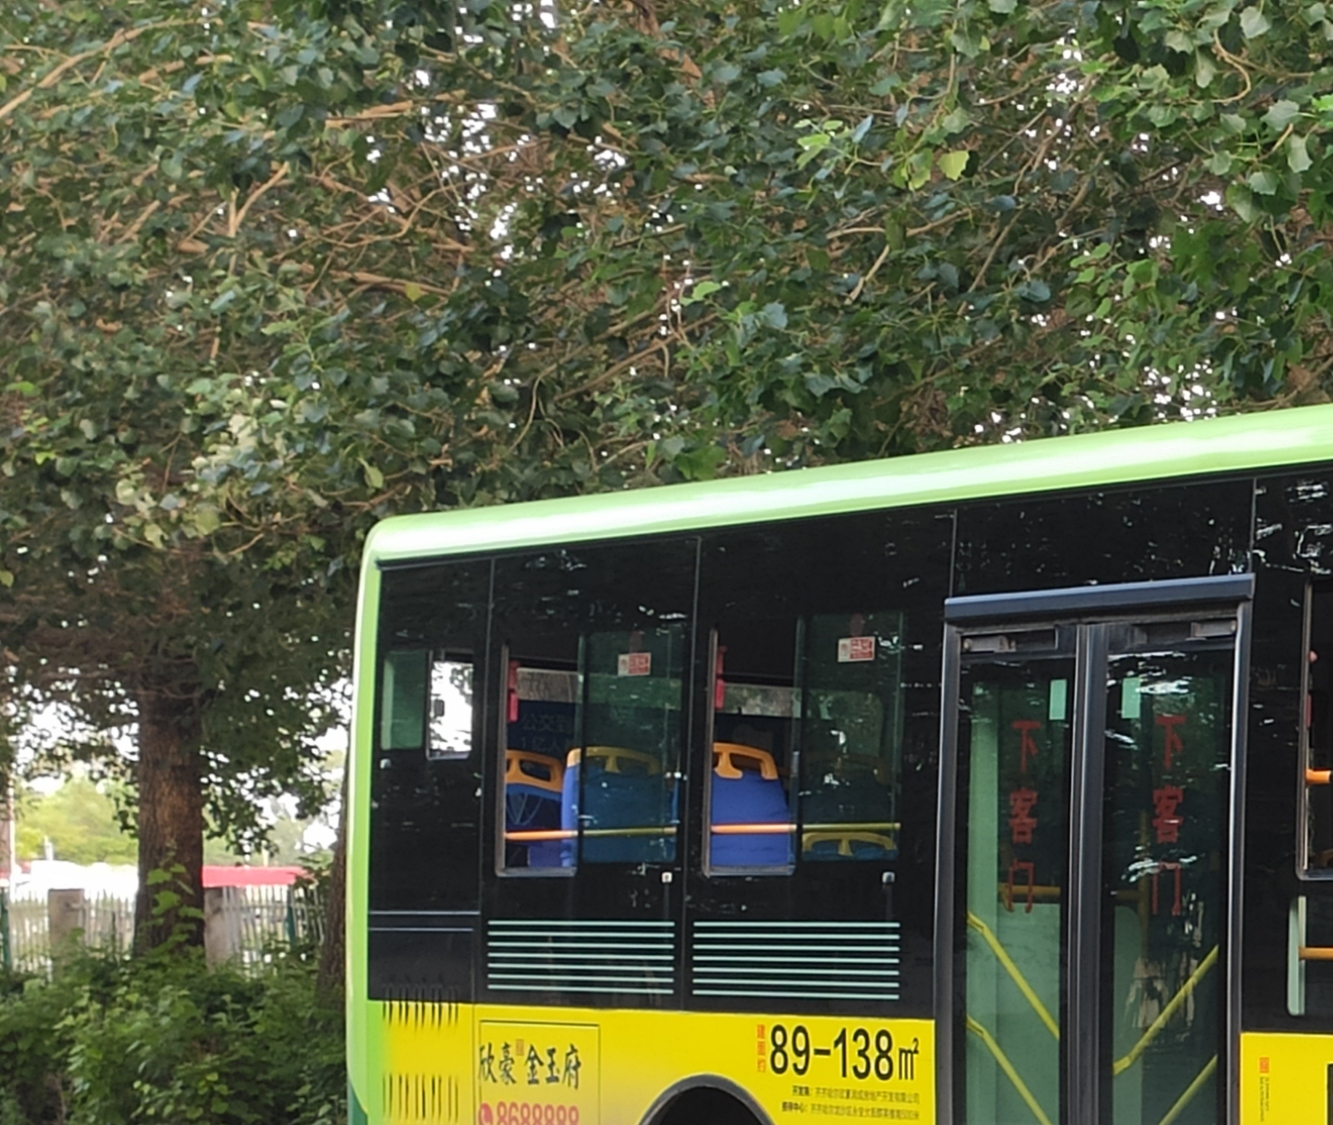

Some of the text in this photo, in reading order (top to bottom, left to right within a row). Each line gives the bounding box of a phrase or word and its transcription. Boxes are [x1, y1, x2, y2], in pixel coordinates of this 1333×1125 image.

[1009, 719, 1041, 914] 下客门
[1153, 715, 1186, 916] 下客门
